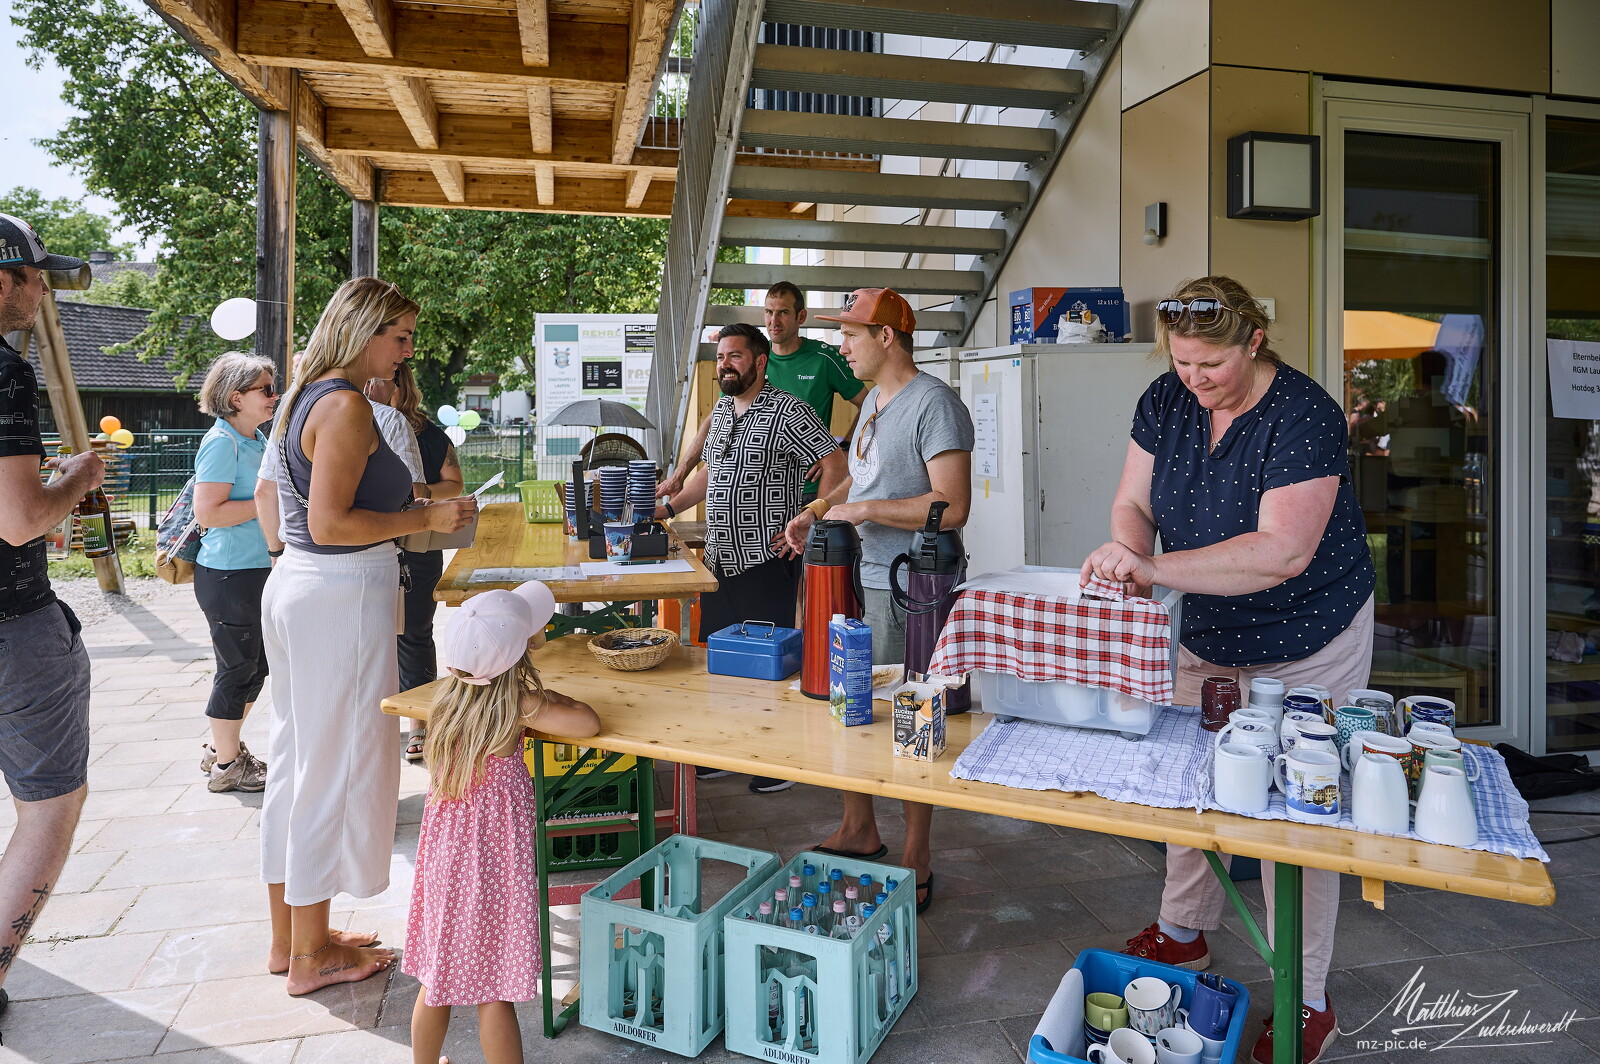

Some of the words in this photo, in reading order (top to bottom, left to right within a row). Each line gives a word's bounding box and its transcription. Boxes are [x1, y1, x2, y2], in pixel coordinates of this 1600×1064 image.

[1572, 366, 1588, 374] RGM
[1571, 383, 1595, 393] Hotdog
[830, 652, 845, 669] LATTE
[613, 1022, 657, 1043] ADLDORFER
[763, 1047, 810, 1064] ADLDORFER
